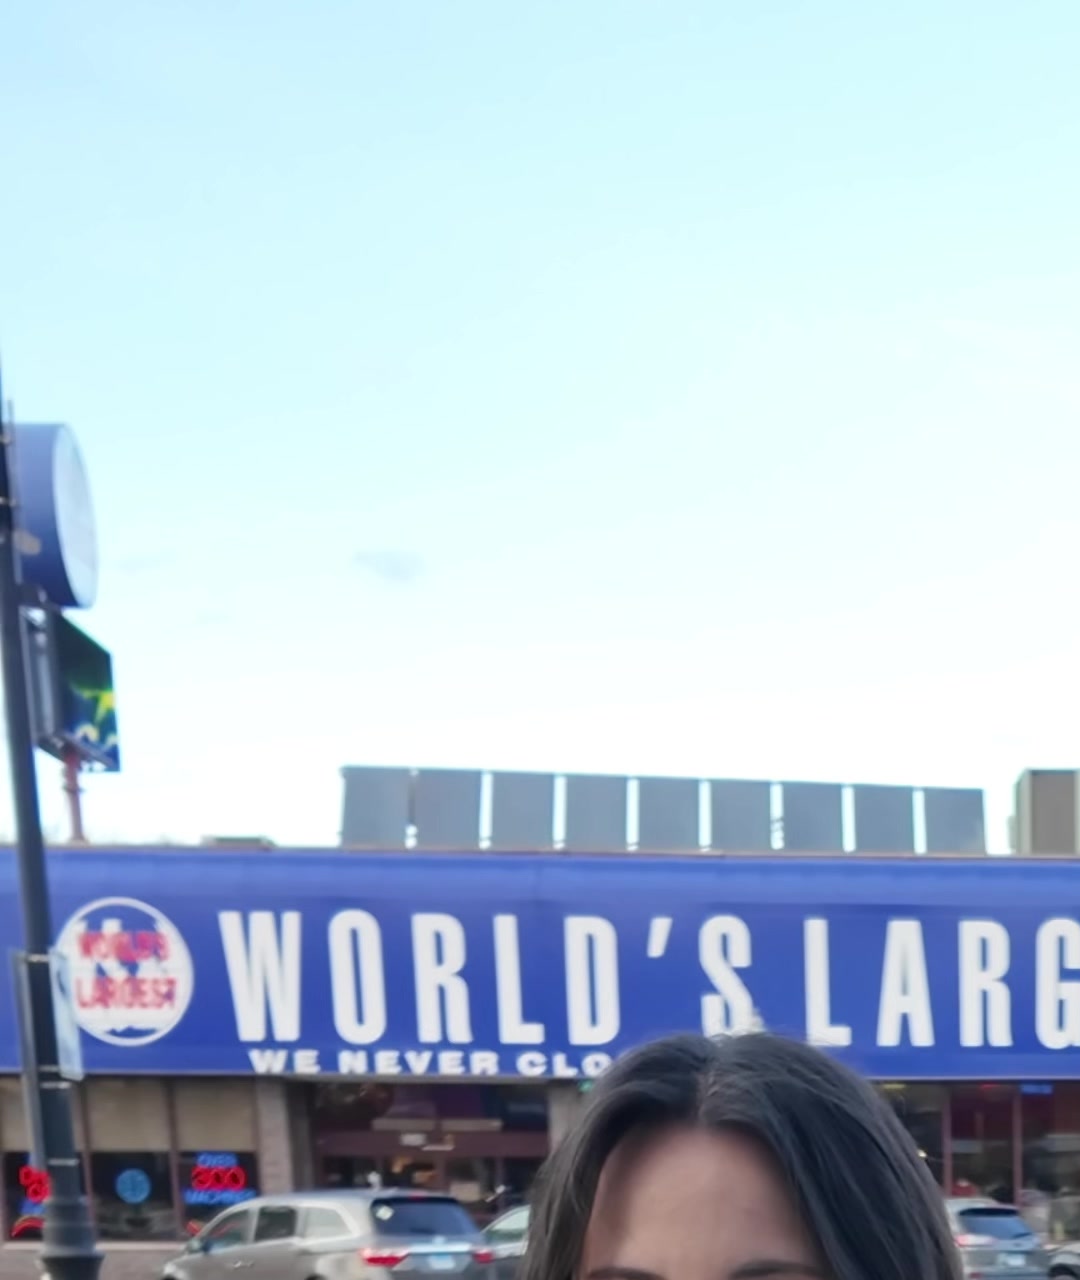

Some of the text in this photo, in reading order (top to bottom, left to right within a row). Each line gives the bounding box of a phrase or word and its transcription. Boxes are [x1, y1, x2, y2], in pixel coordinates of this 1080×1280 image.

[75, 976, 176, 1009] LARGEST
[217, 908, 756, 1045] WORLD'S
[248, 1049, 614, 1077] WE NEVER CLO
